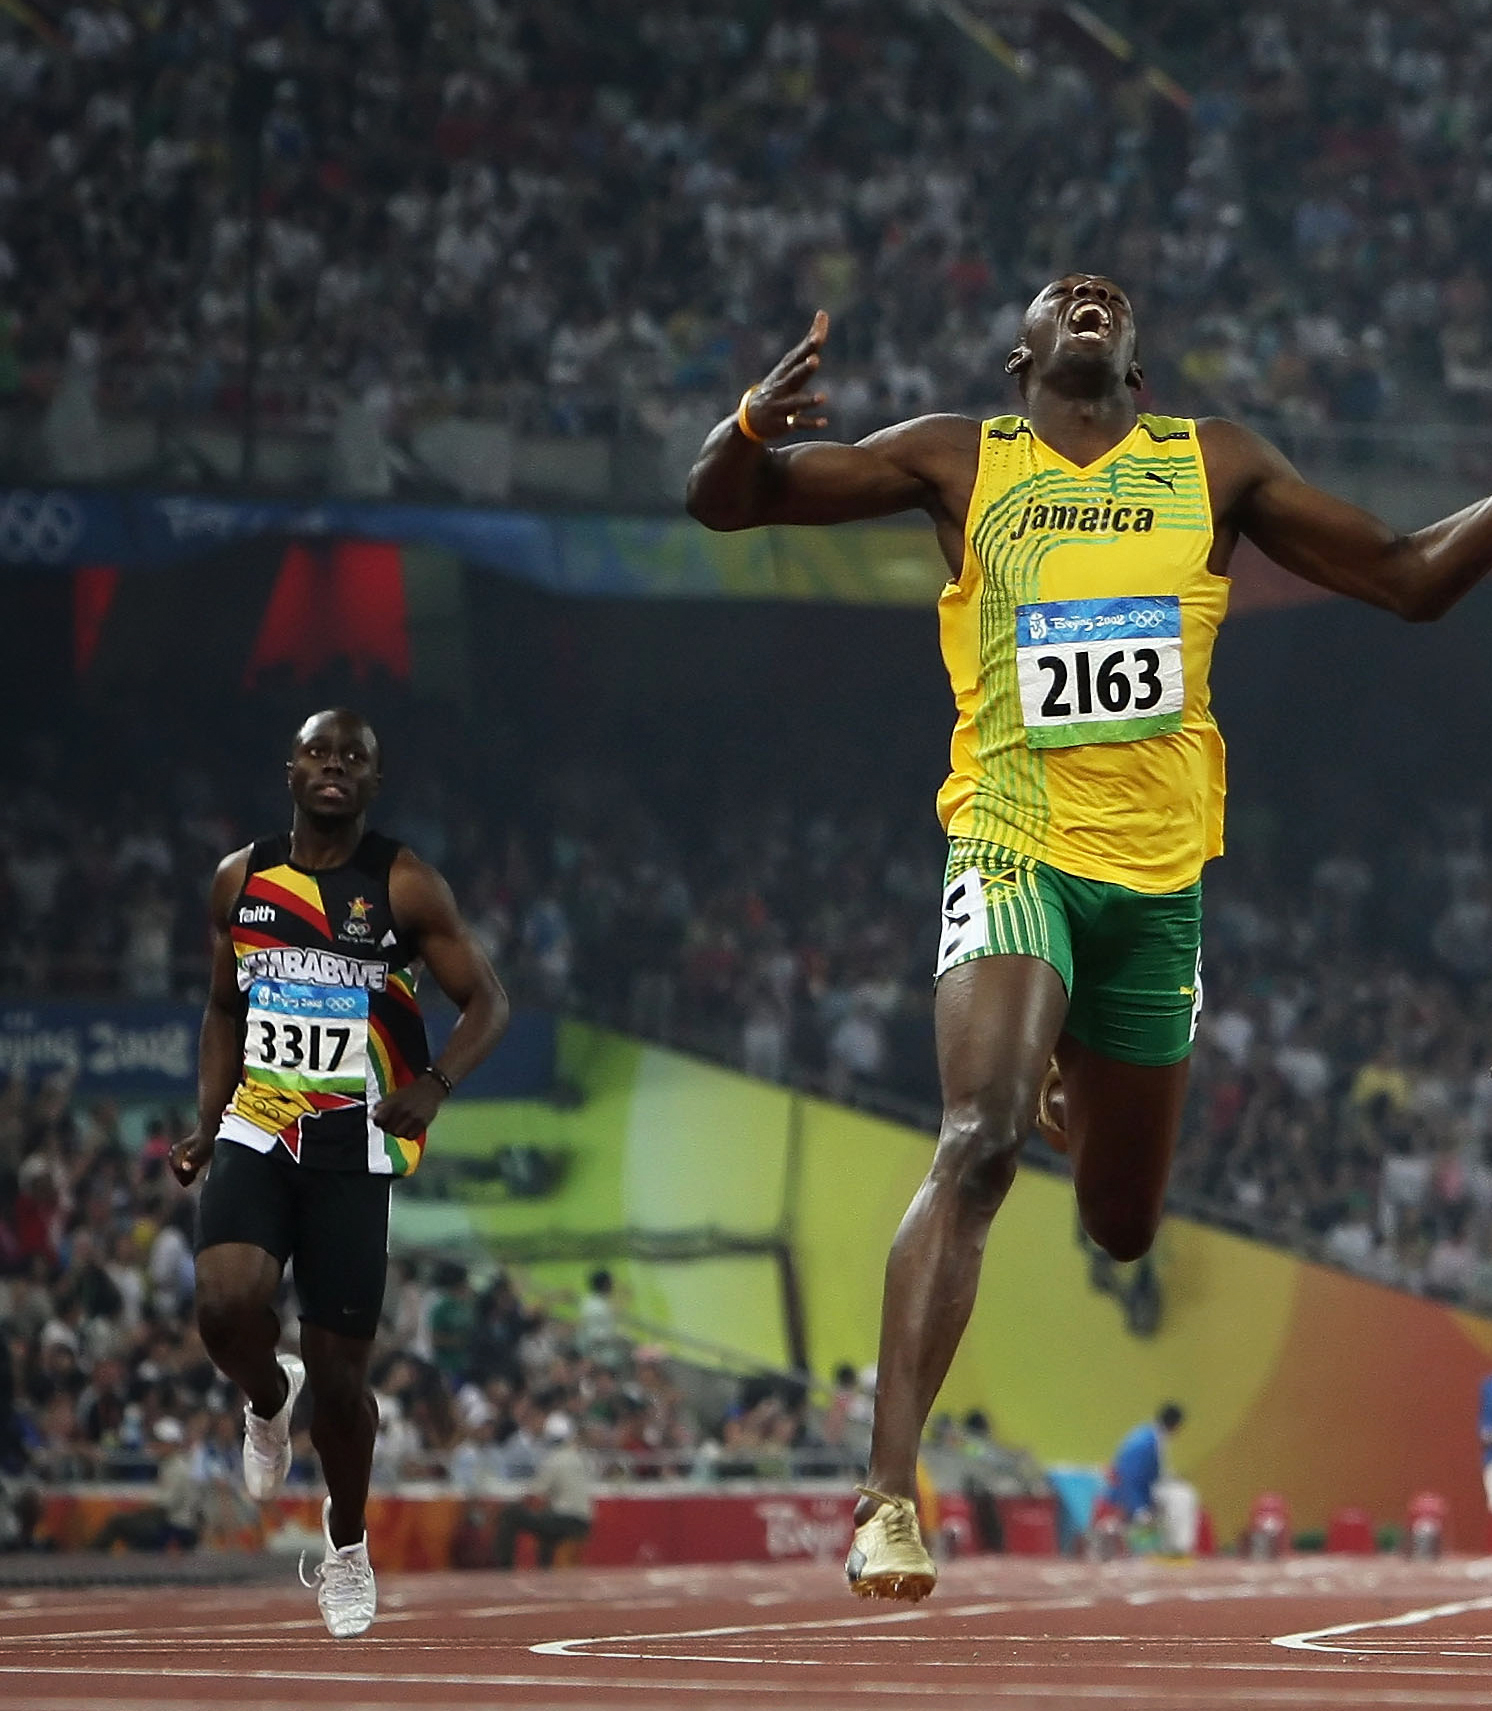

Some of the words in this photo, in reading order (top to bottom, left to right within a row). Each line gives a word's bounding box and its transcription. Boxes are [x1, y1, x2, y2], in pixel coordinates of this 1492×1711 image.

[1011, 496, 1155, 541] jamaica
[1050, 614, 1094, 632] Beijing
[1096, 613, 1126, 627] 2008
[1037, 648, 1163, 718] 2163
[238, 905, 276, 924] faith
[259, 1020, 351, 1072] 3317
